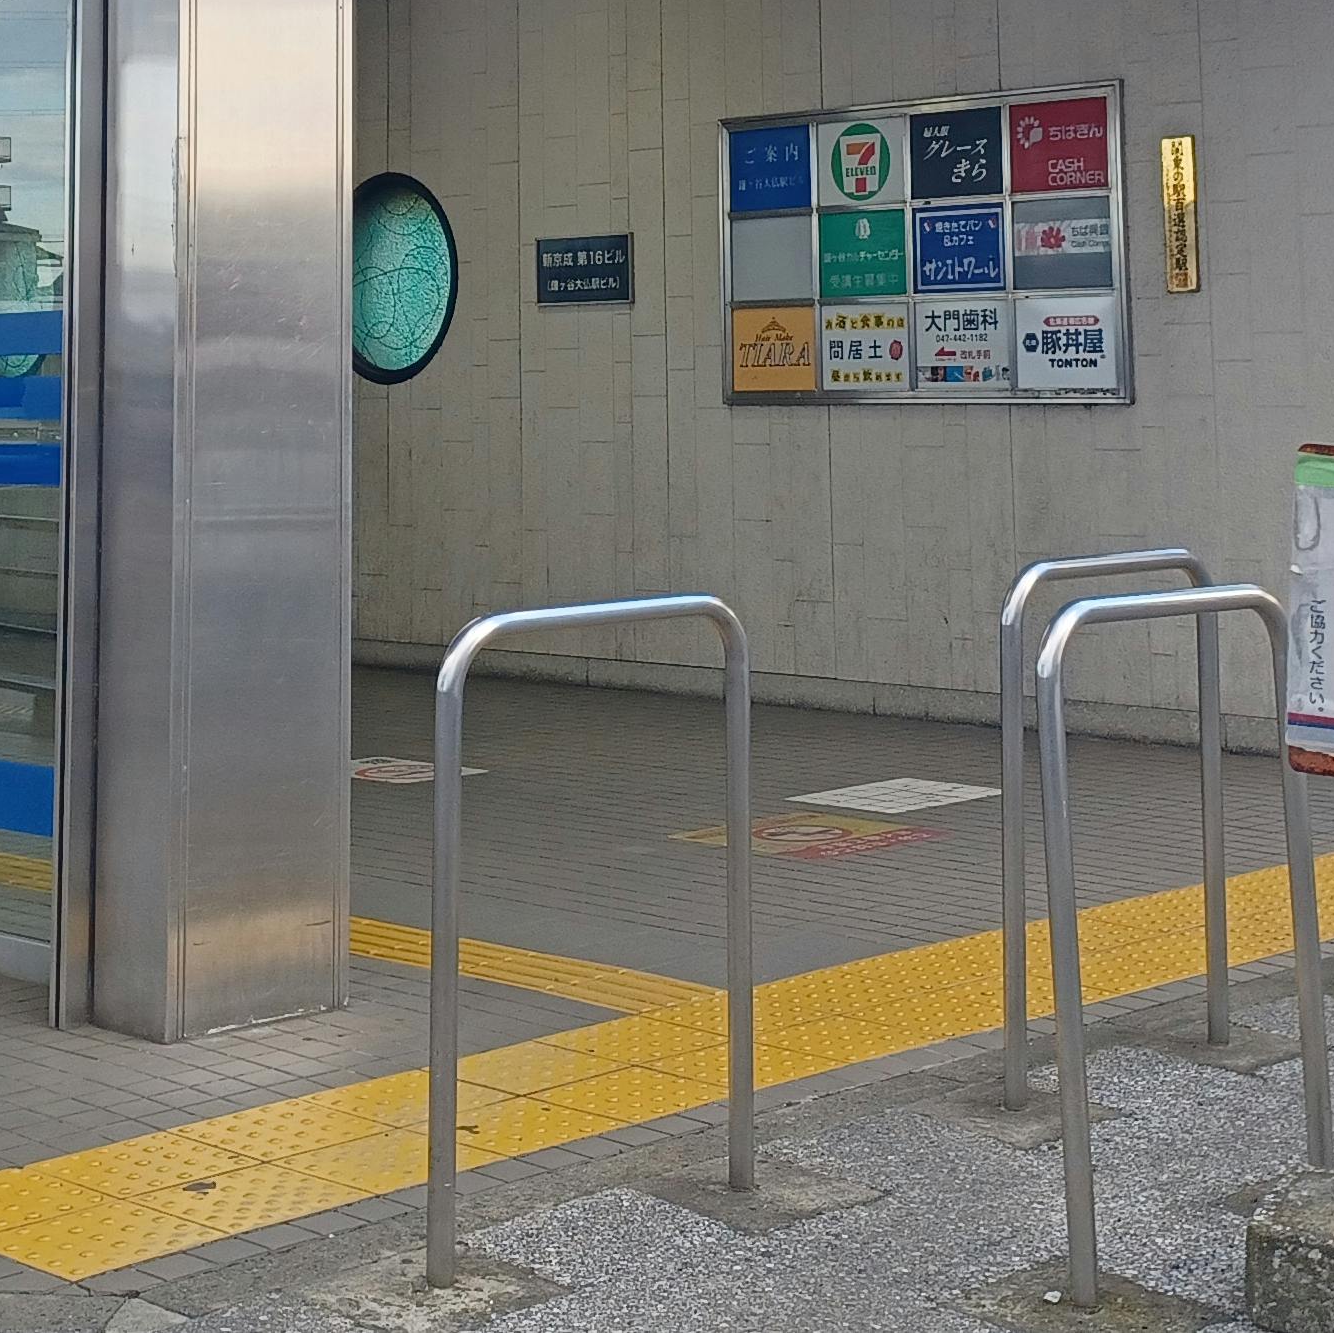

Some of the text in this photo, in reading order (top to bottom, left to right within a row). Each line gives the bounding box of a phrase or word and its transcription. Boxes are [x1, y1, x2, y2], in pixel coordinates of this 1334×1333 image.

[923, 138, 988, 161] グレース
[951, 158, 988, 183] きら
[1047, 157, 1085, 173] CASH
[1048, 169, 1105, 186] CORNER
[924, 308, 999, 332] 大門歯科
[935, 333, 988, 343] 047-442-1182
[1041, 328, 1105, 355] 豚丼屋
[739, 342, 811, 367] TIARA
[1049, 358, 1098, 368] TONTON
